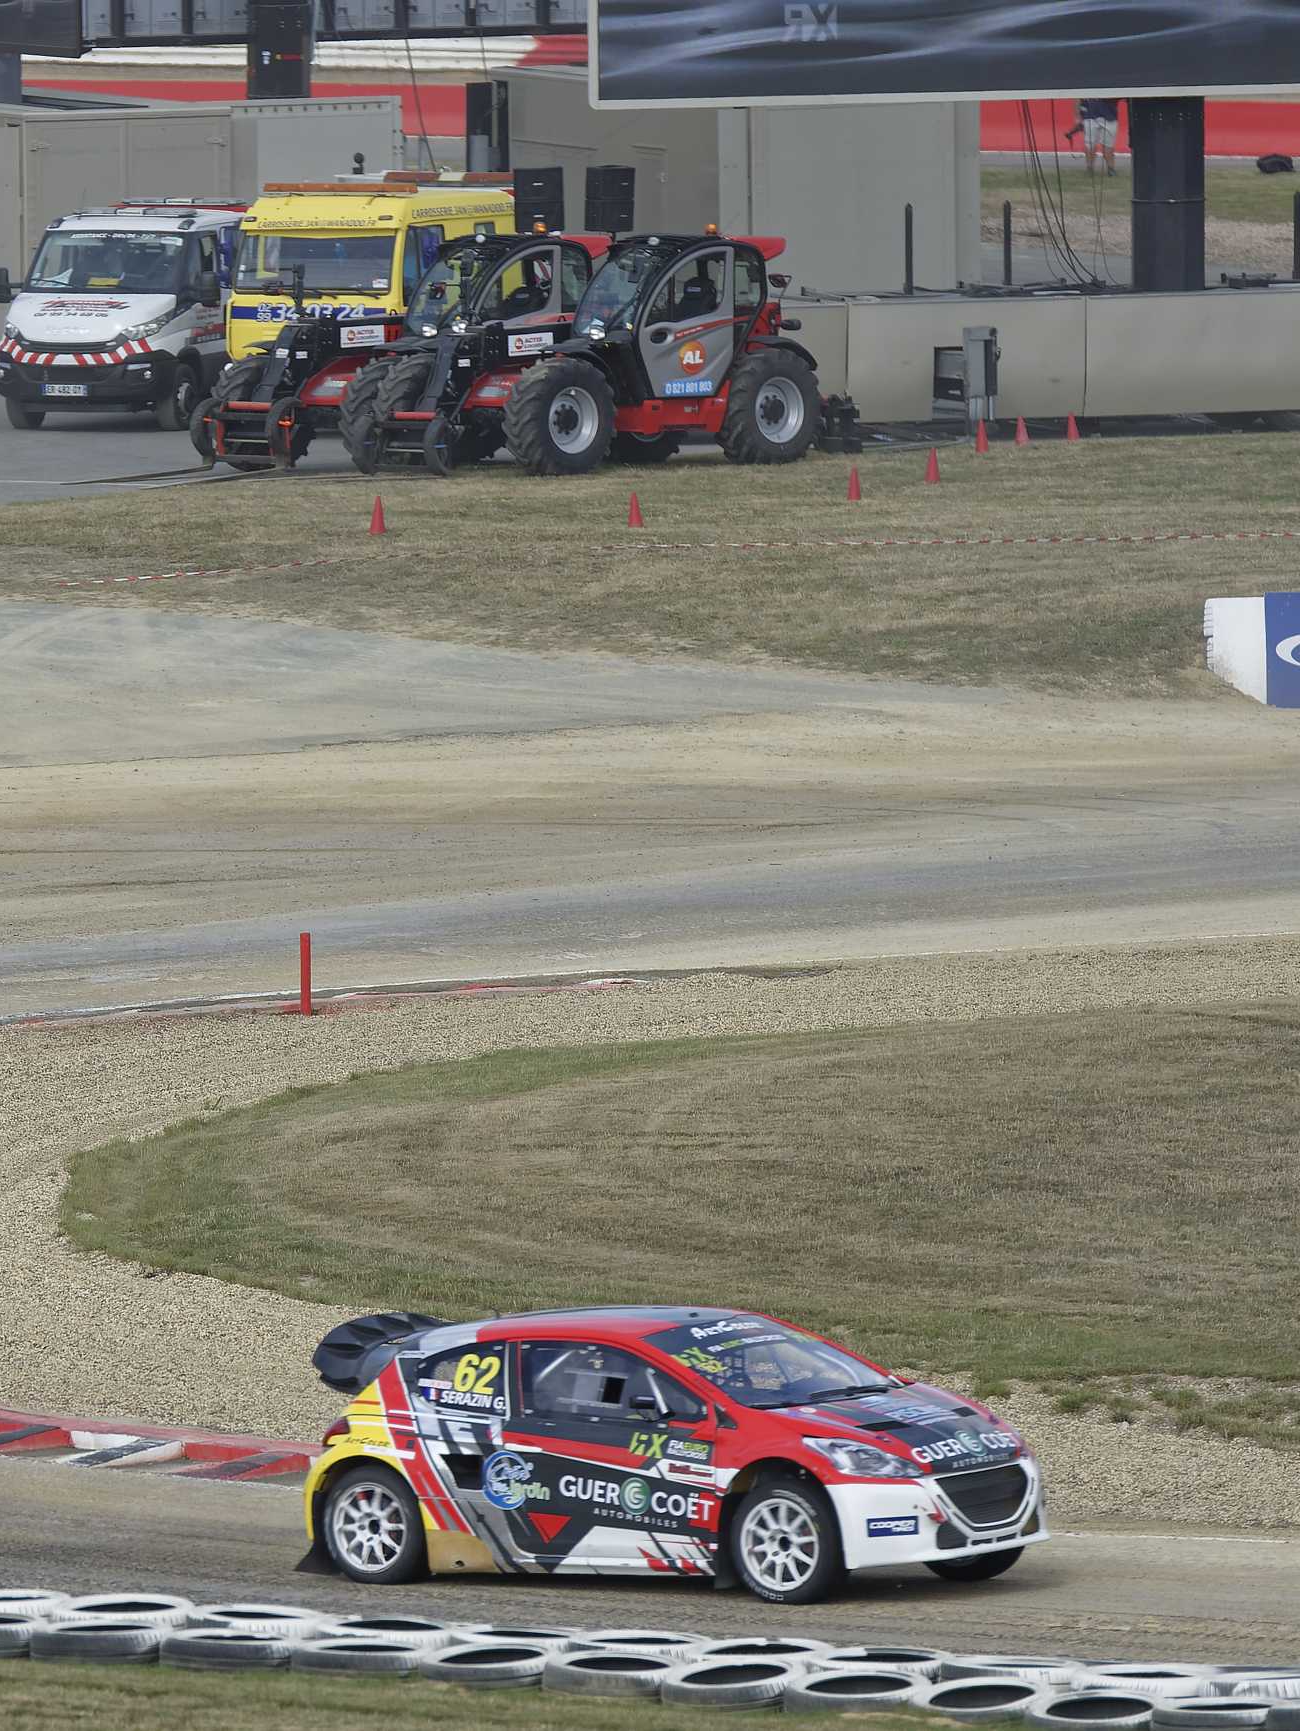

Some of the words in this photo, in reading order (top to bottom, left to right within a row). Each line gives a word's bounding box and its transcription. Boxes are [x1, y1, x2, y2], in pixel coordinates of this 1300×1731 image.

[272, 303, 300, 322] 34
[337, 304, 365, 320] 24
[683, 350, 704, 365] AL
[665, 384, 672, 394] 0
[454, 1354, 501, 1395] 62
[440, 1390, 493, 1408] SERAZIN
[493, 1396, 507, 1410] G.
[911, 1438, 969, 1463] GUER
[558, 1474, 621, 1506] GUER
[651, 1492, 716, 1521] COËT
[593, 1507, 679, 1528] AUTOMOBILES
